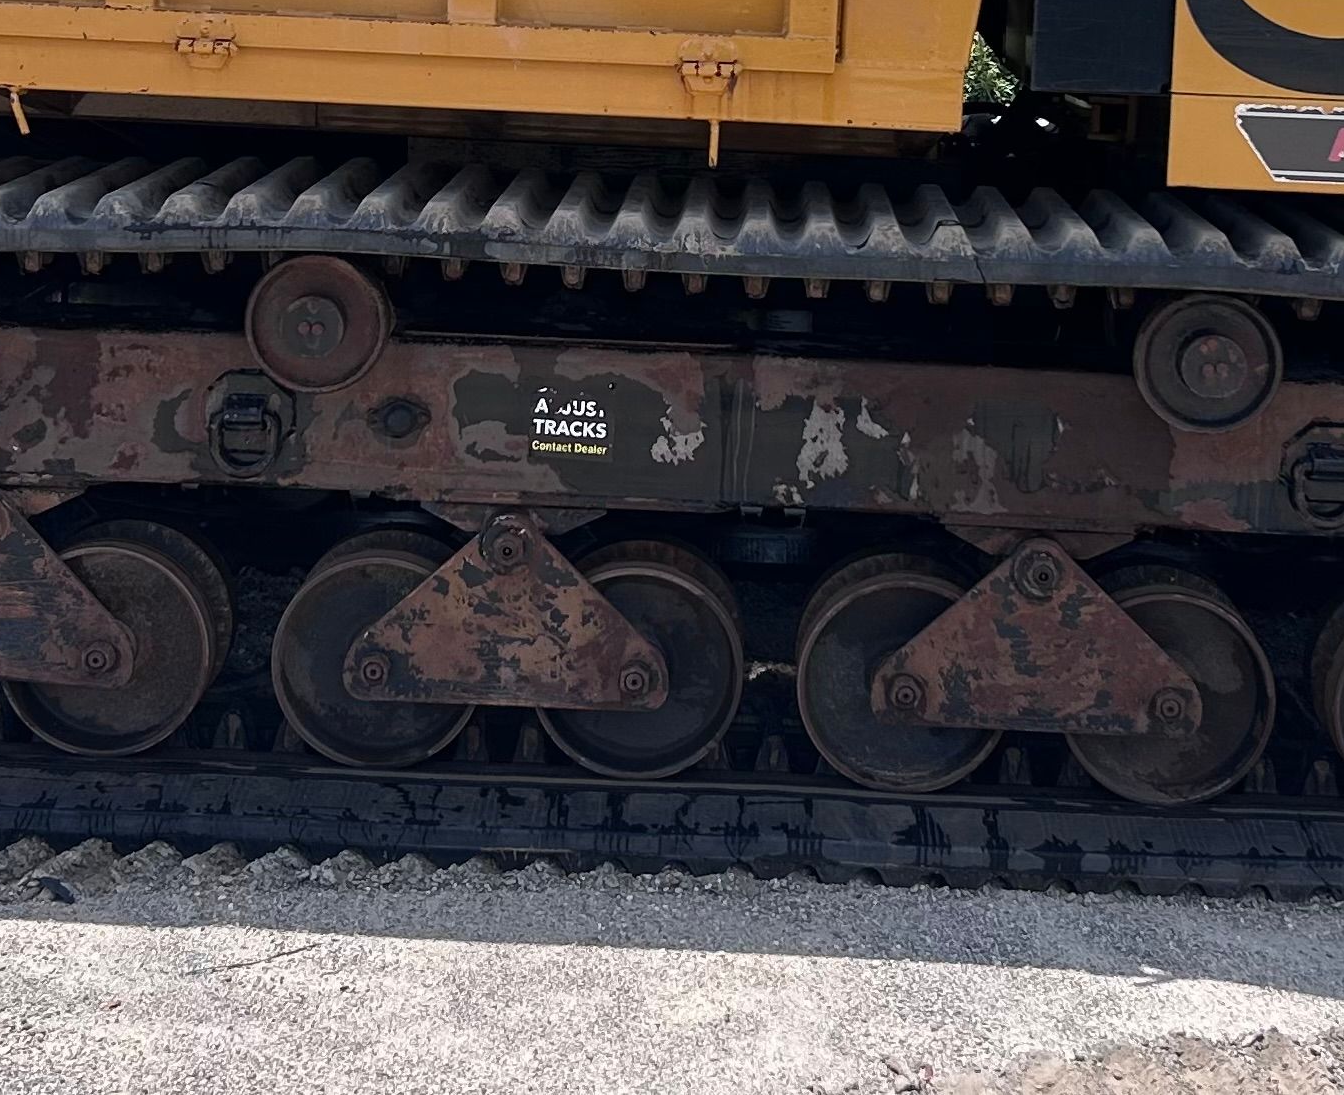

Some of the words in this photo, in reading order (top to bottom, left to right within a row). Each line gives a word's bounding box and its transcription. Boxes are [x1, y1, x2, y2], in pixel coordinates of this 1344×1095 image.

[533, 418, 607, 438] TRACKS
[531, 440, 572, 453] Contact
[574, 442, 608, 455] Dealer
